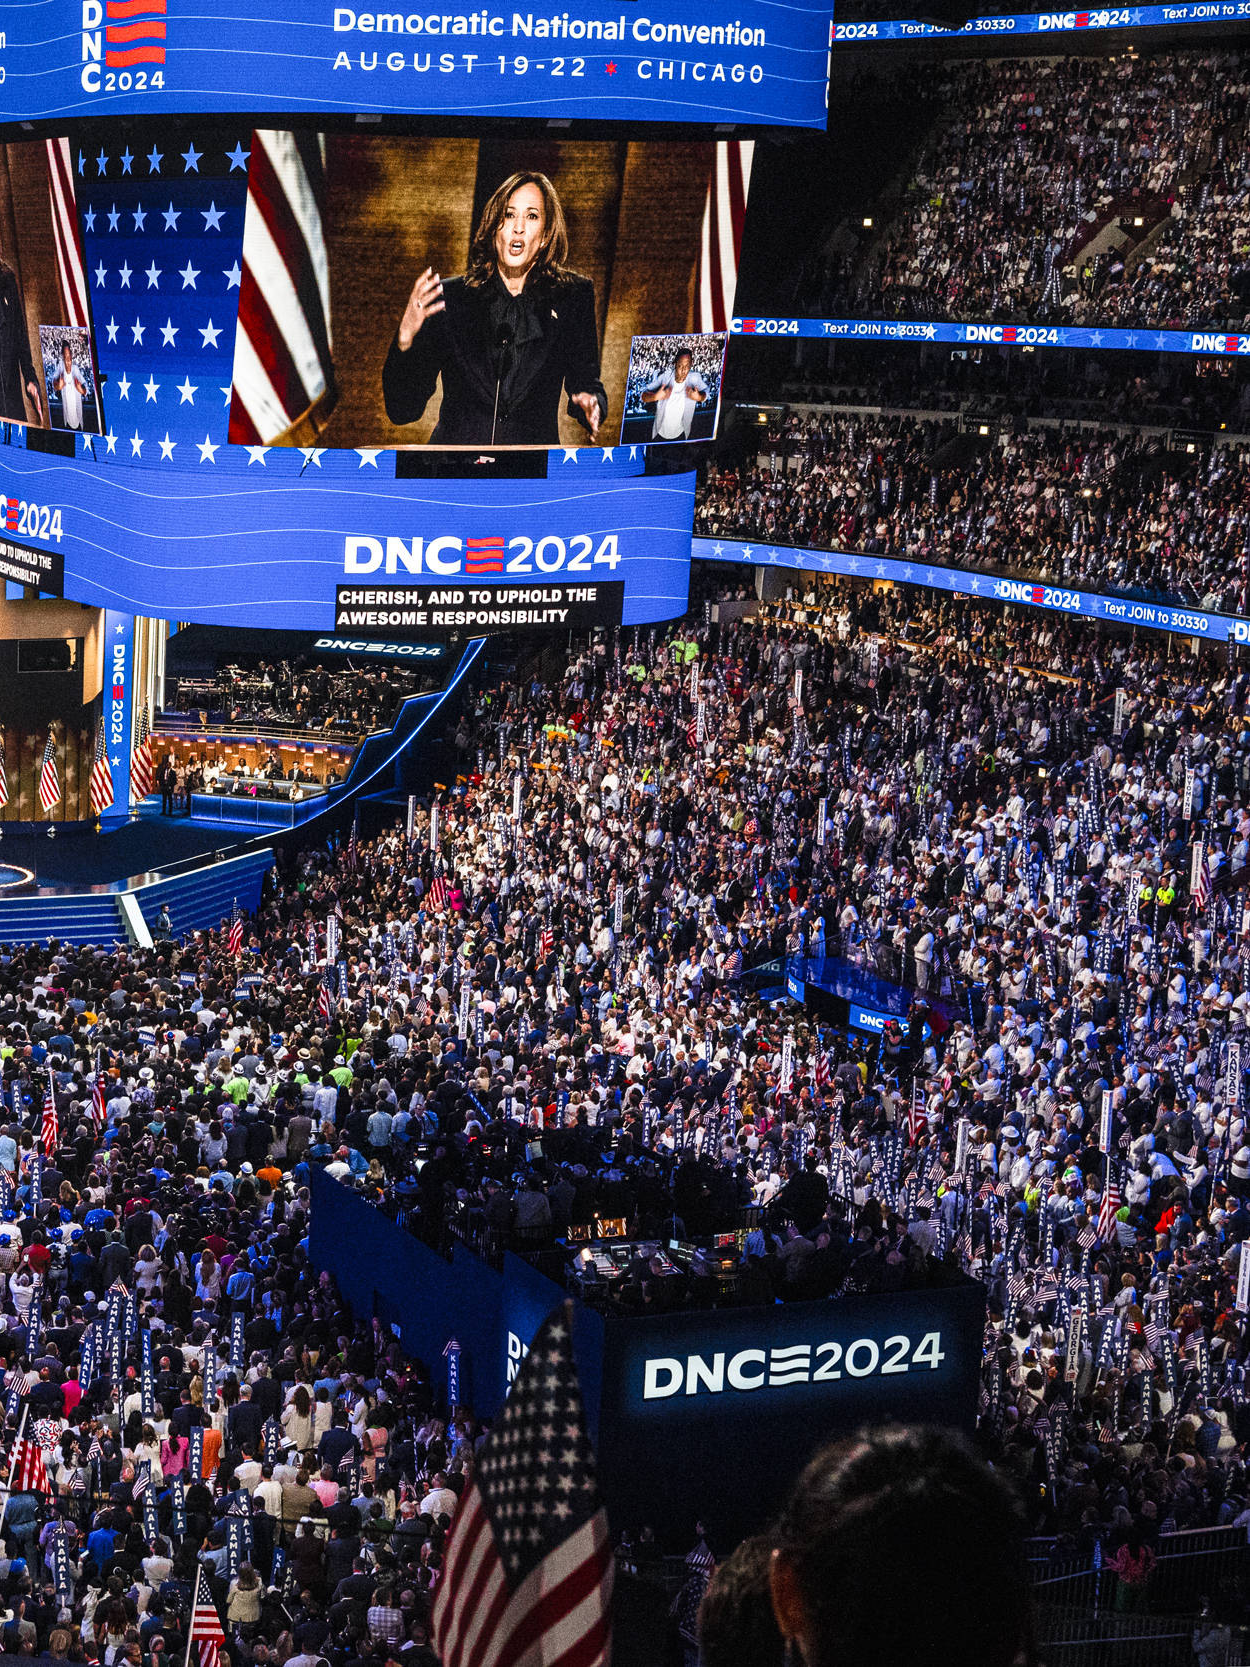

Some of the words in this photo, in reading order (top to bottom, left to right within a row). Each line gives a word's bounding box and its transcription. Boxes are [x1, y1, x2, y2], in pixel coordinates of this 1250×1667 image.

[334, 8, 504, 37] Democratic
[511, 14, 626, 41] National
[632, 18, 766, 47] Convention
[836, 24, 878, 38] 2024
[901, 23, 925, 34] Text
[976, 18, 1015, 30] 30330
[1162, 8, 1183, 19] Text
[1189, 5, 1219, 17] JOIN
[1222, 4, 1234, 15] to
[105, 71, 165, 91] 2024
[333, 52, 479, 74] AUGUST
[498, 55, 585, 77] 19-22
[638, 60, 764, 84] CHICAGO
[756, 320, 799, 334] 2024
[823, 323, 848, 334] Text
[851, 323, 881, 335] JOIN
[884, 325, 896, 335] to
[966, 326, 1003, 341] DNC
[1016, 328, 1058, 343] 2024
[17, 501, 63, 543] 2024
[7, 545, 14, 558] TO
[15, 547, 38, 566] UPHOLD
[39, 554, 52, 570] THE
[344, 536, 463, 575] DNC
[506, 535, 622, 573] 2024
[337, 611, 427, 625] AWESOME
[432, 609, 569, 625] RESPONSIBILITY
[338, 590, 423, 607] CHERISH,
[427, 590, 464, 605] AND
[469, 590, 491, 604] TO
[496, 589, 562, 604] UPHOLD
[566, 588, 597, 602] THE
[1000, 581, 1033, 602] DNC
[1043, 590, 1080, 610] 2024
[1104, 601, 1126, 616] Text
[1128, 606, 1155, 622] JOIN
[1158, 612, 1169, 624] to
[1171, 613, 1208, 631] 30330
[112, 644, 125, 685] DNC
[384, 645, 442, 657] 2024
[111, 700, 124, 744] 2024
[1185, 775, 1193, 813] WYOMING
[1129, 877, 1140, 917] NEVADA
[860, 1013, 884, 1029] DNC
[1228, 1051, 1237, 1096] KANSAS
[232, 1317, 241, 1360] KAMALA
[1069, 1317, 1079, 1369] GEORGIA
[1099, 1319, 1113, 1363] KAMALA
[206, 1353, 214, 1398] KAMALA
[643, 1349, 767, 1400] DNC
[813, 1332, 945, 1382] 2024
[1163, 1339, 1174, 1382] KAMALA
[57, 1539, 67, 1588] KAMALA
